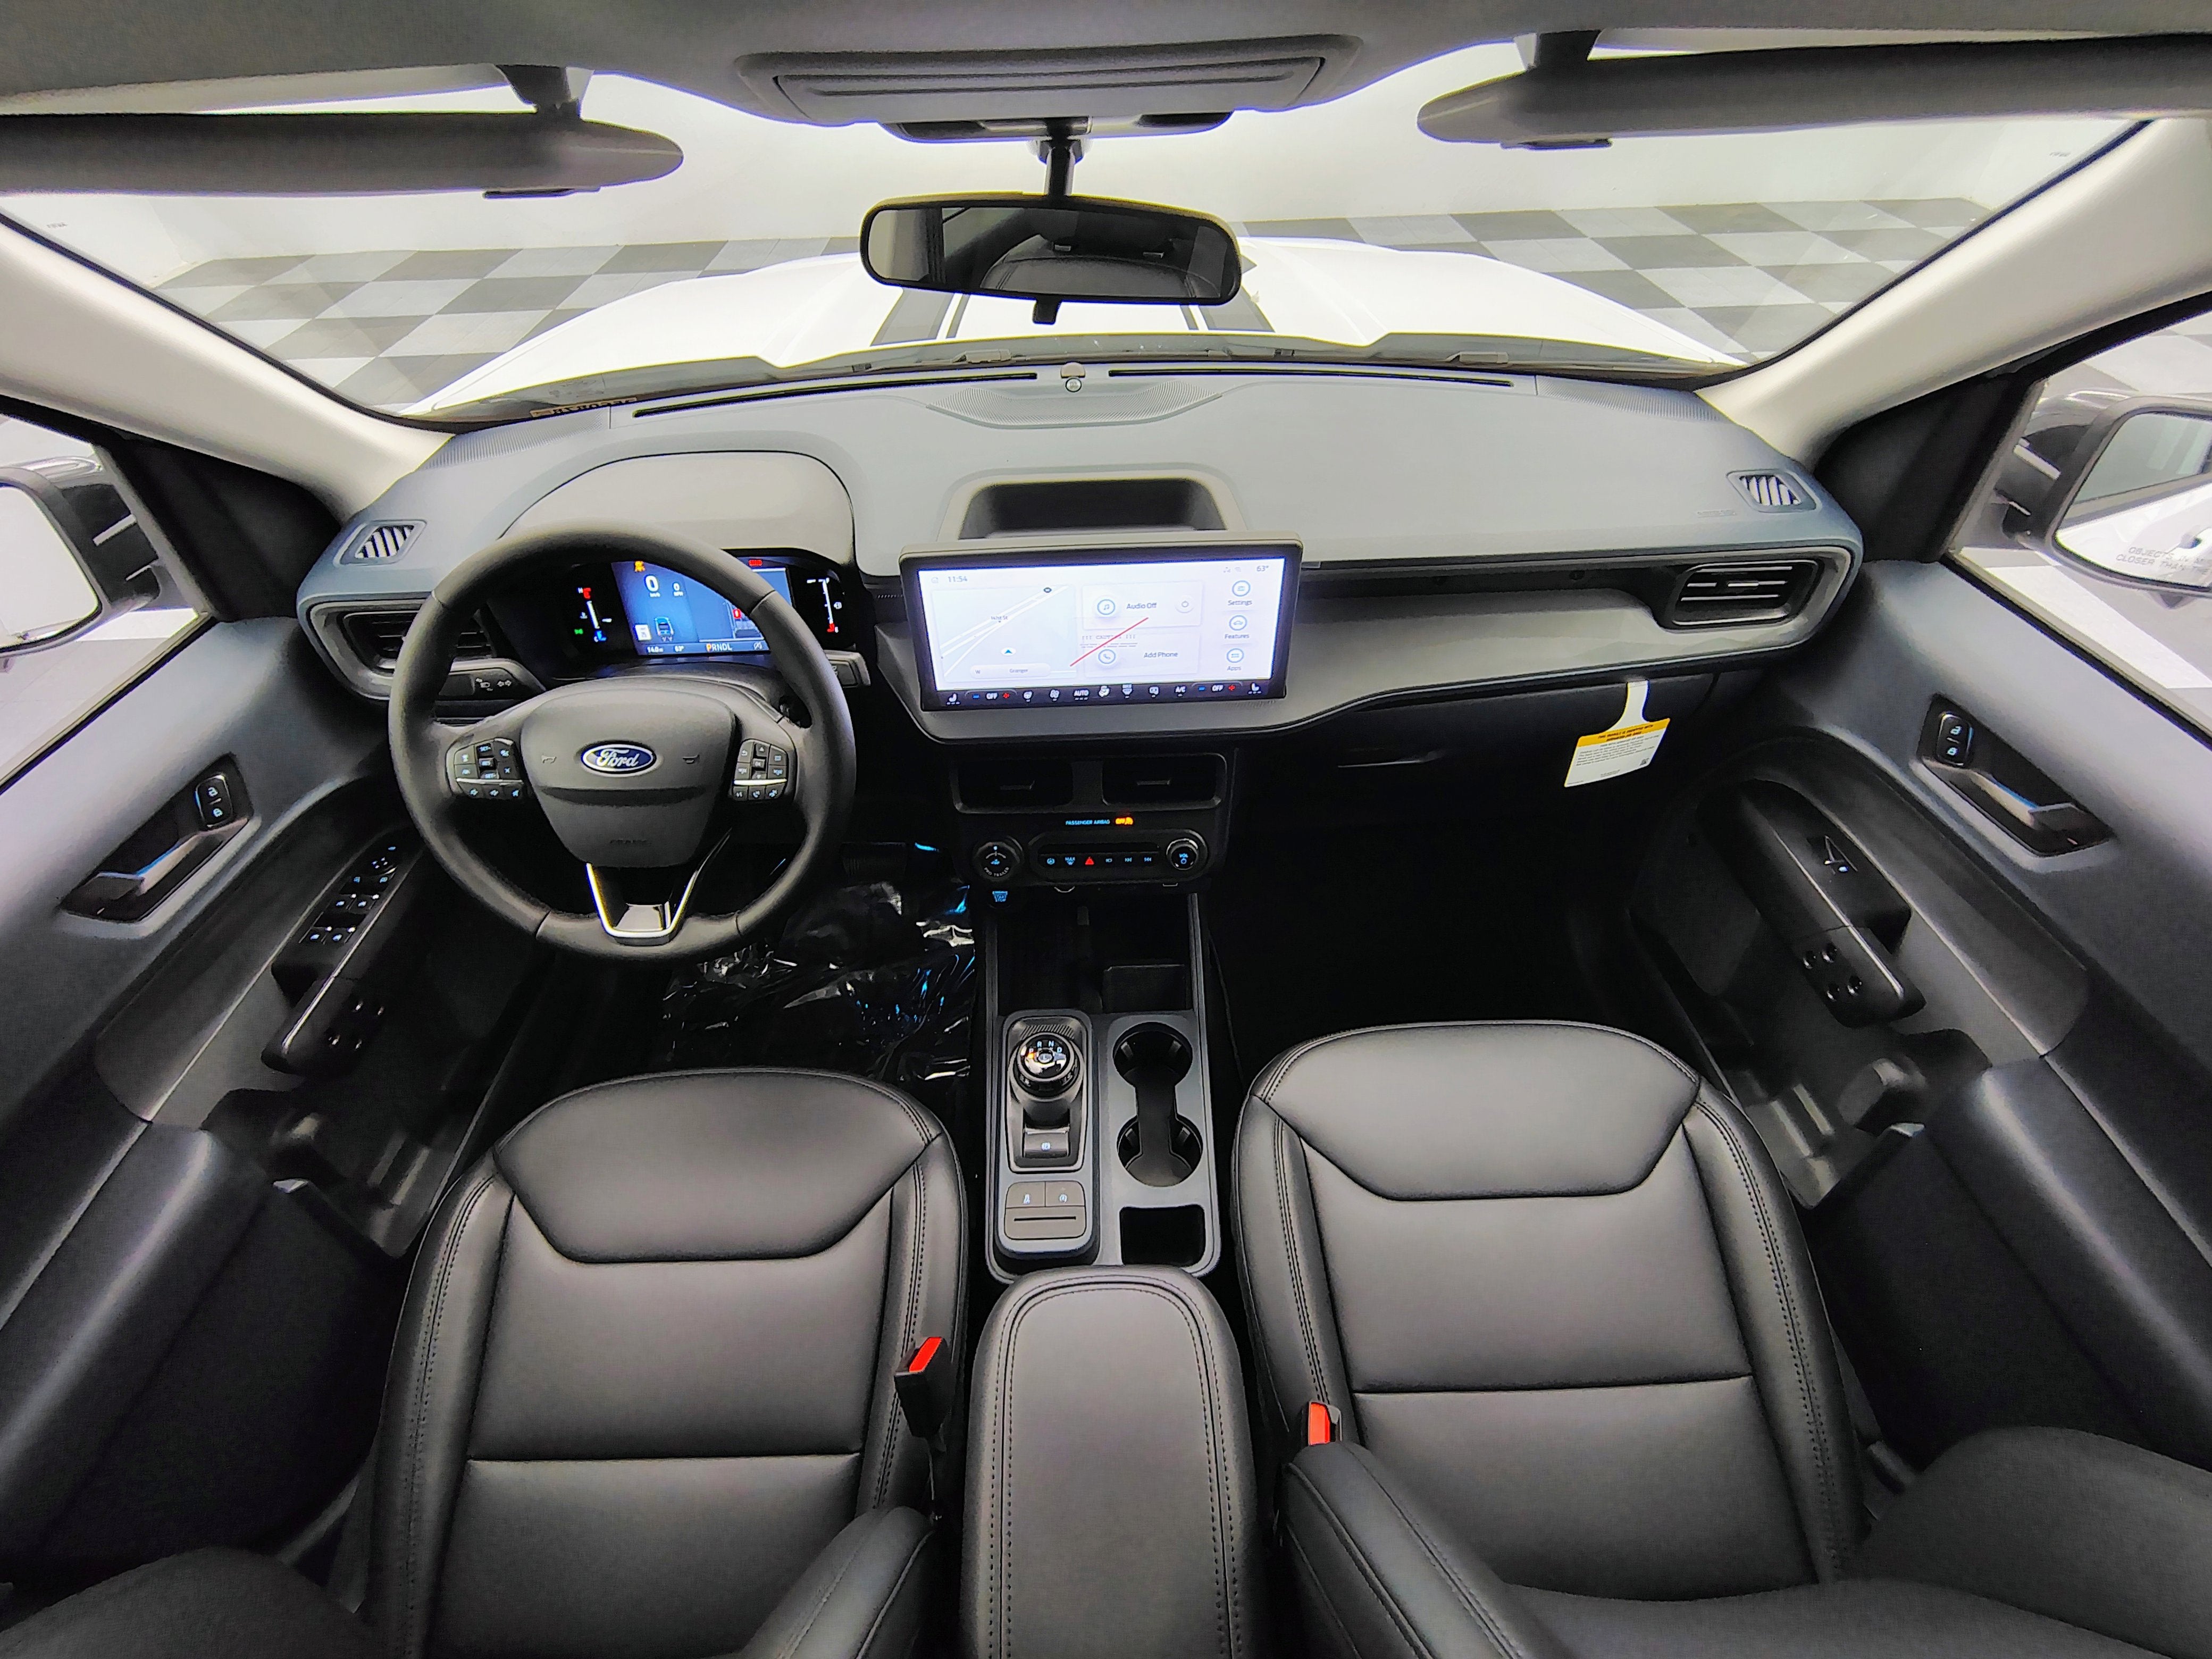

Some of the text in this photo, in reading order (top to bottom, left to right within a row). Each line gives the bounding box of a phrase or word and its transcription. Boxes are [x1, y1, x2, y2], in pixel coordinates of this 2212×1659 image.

[2116, 554, 2155, 565] CLOSER
[645, 575, 659, 592] 0
[597, 748, 640, 767] Ford
